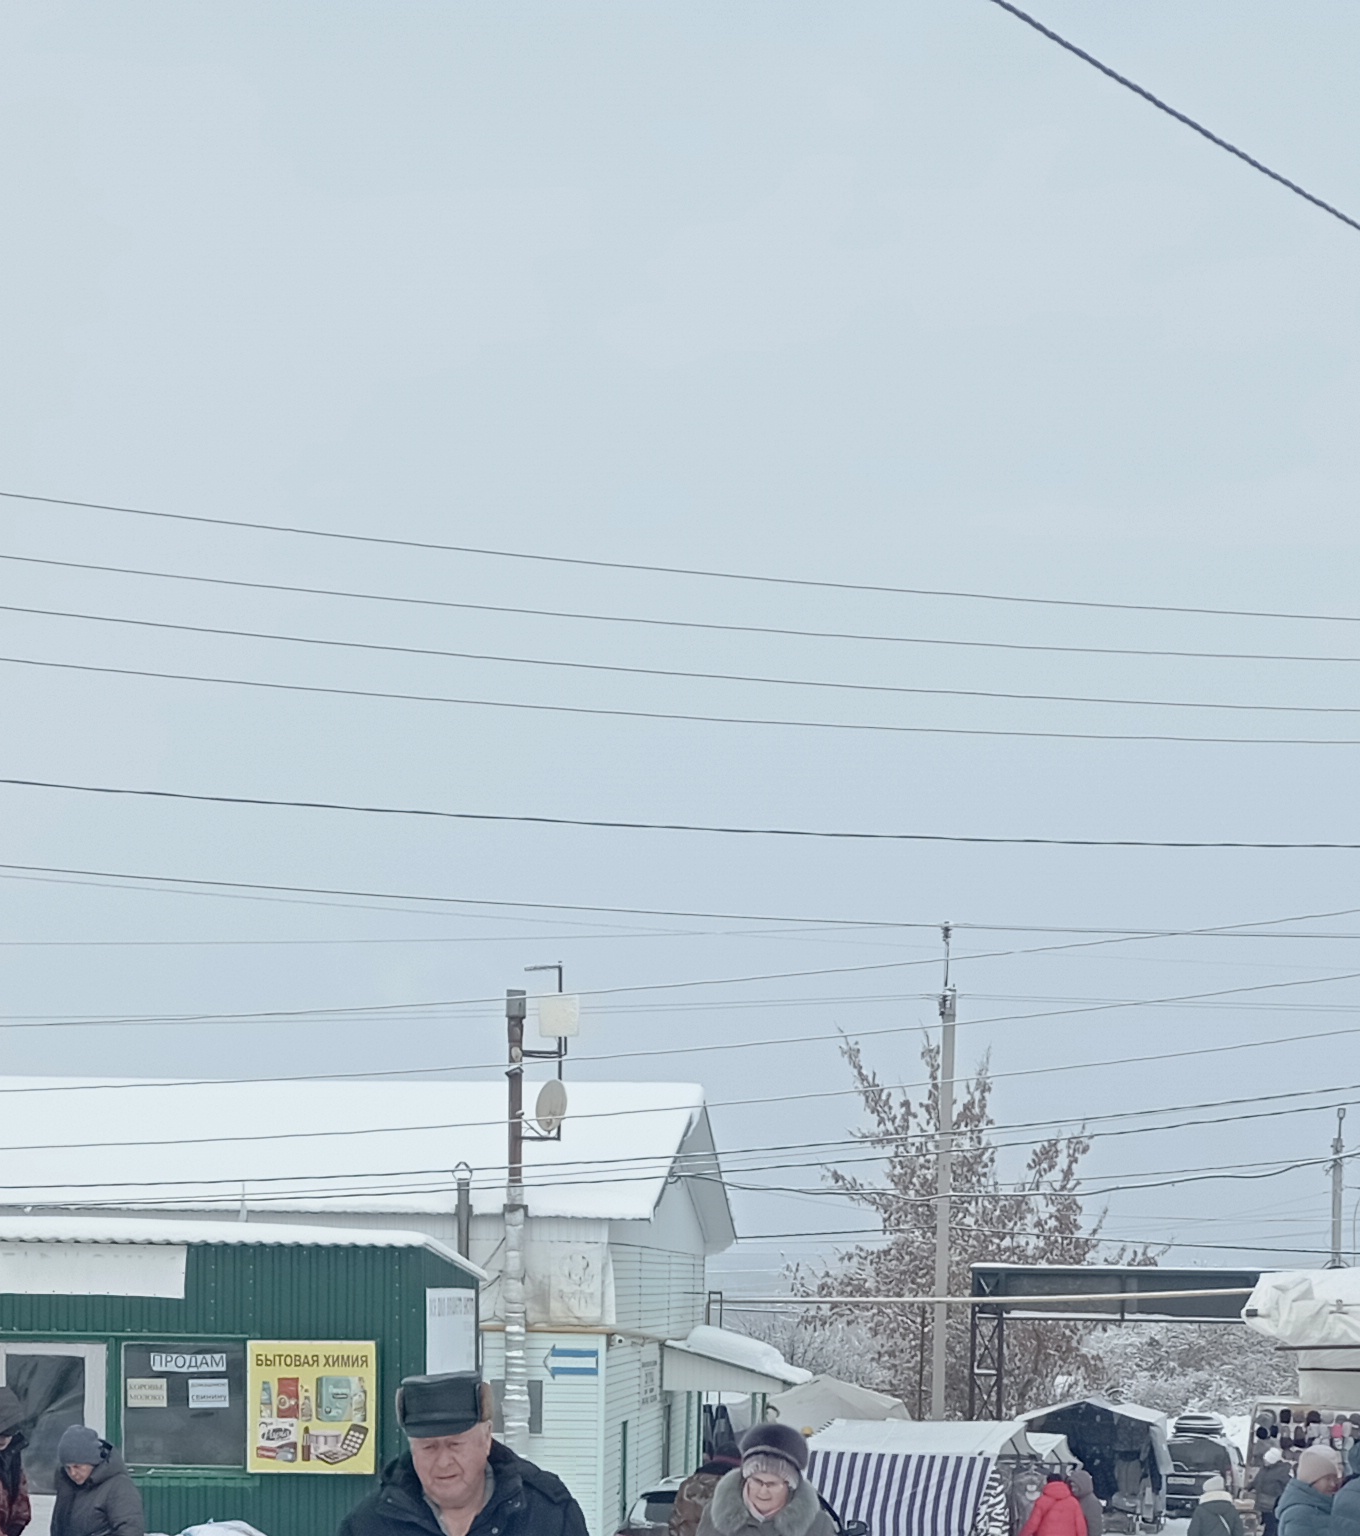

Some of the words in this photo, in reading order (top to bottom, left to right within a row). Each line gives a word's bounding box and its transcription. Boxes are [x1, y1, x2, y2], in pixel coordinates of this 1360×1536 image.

[152, 1354, 225, 1370] ПРОДАМ
[255, 1353, 319, 1368] БЫТОВАЯ
[323, 1355, 368, 1368] ХИМИЯ
